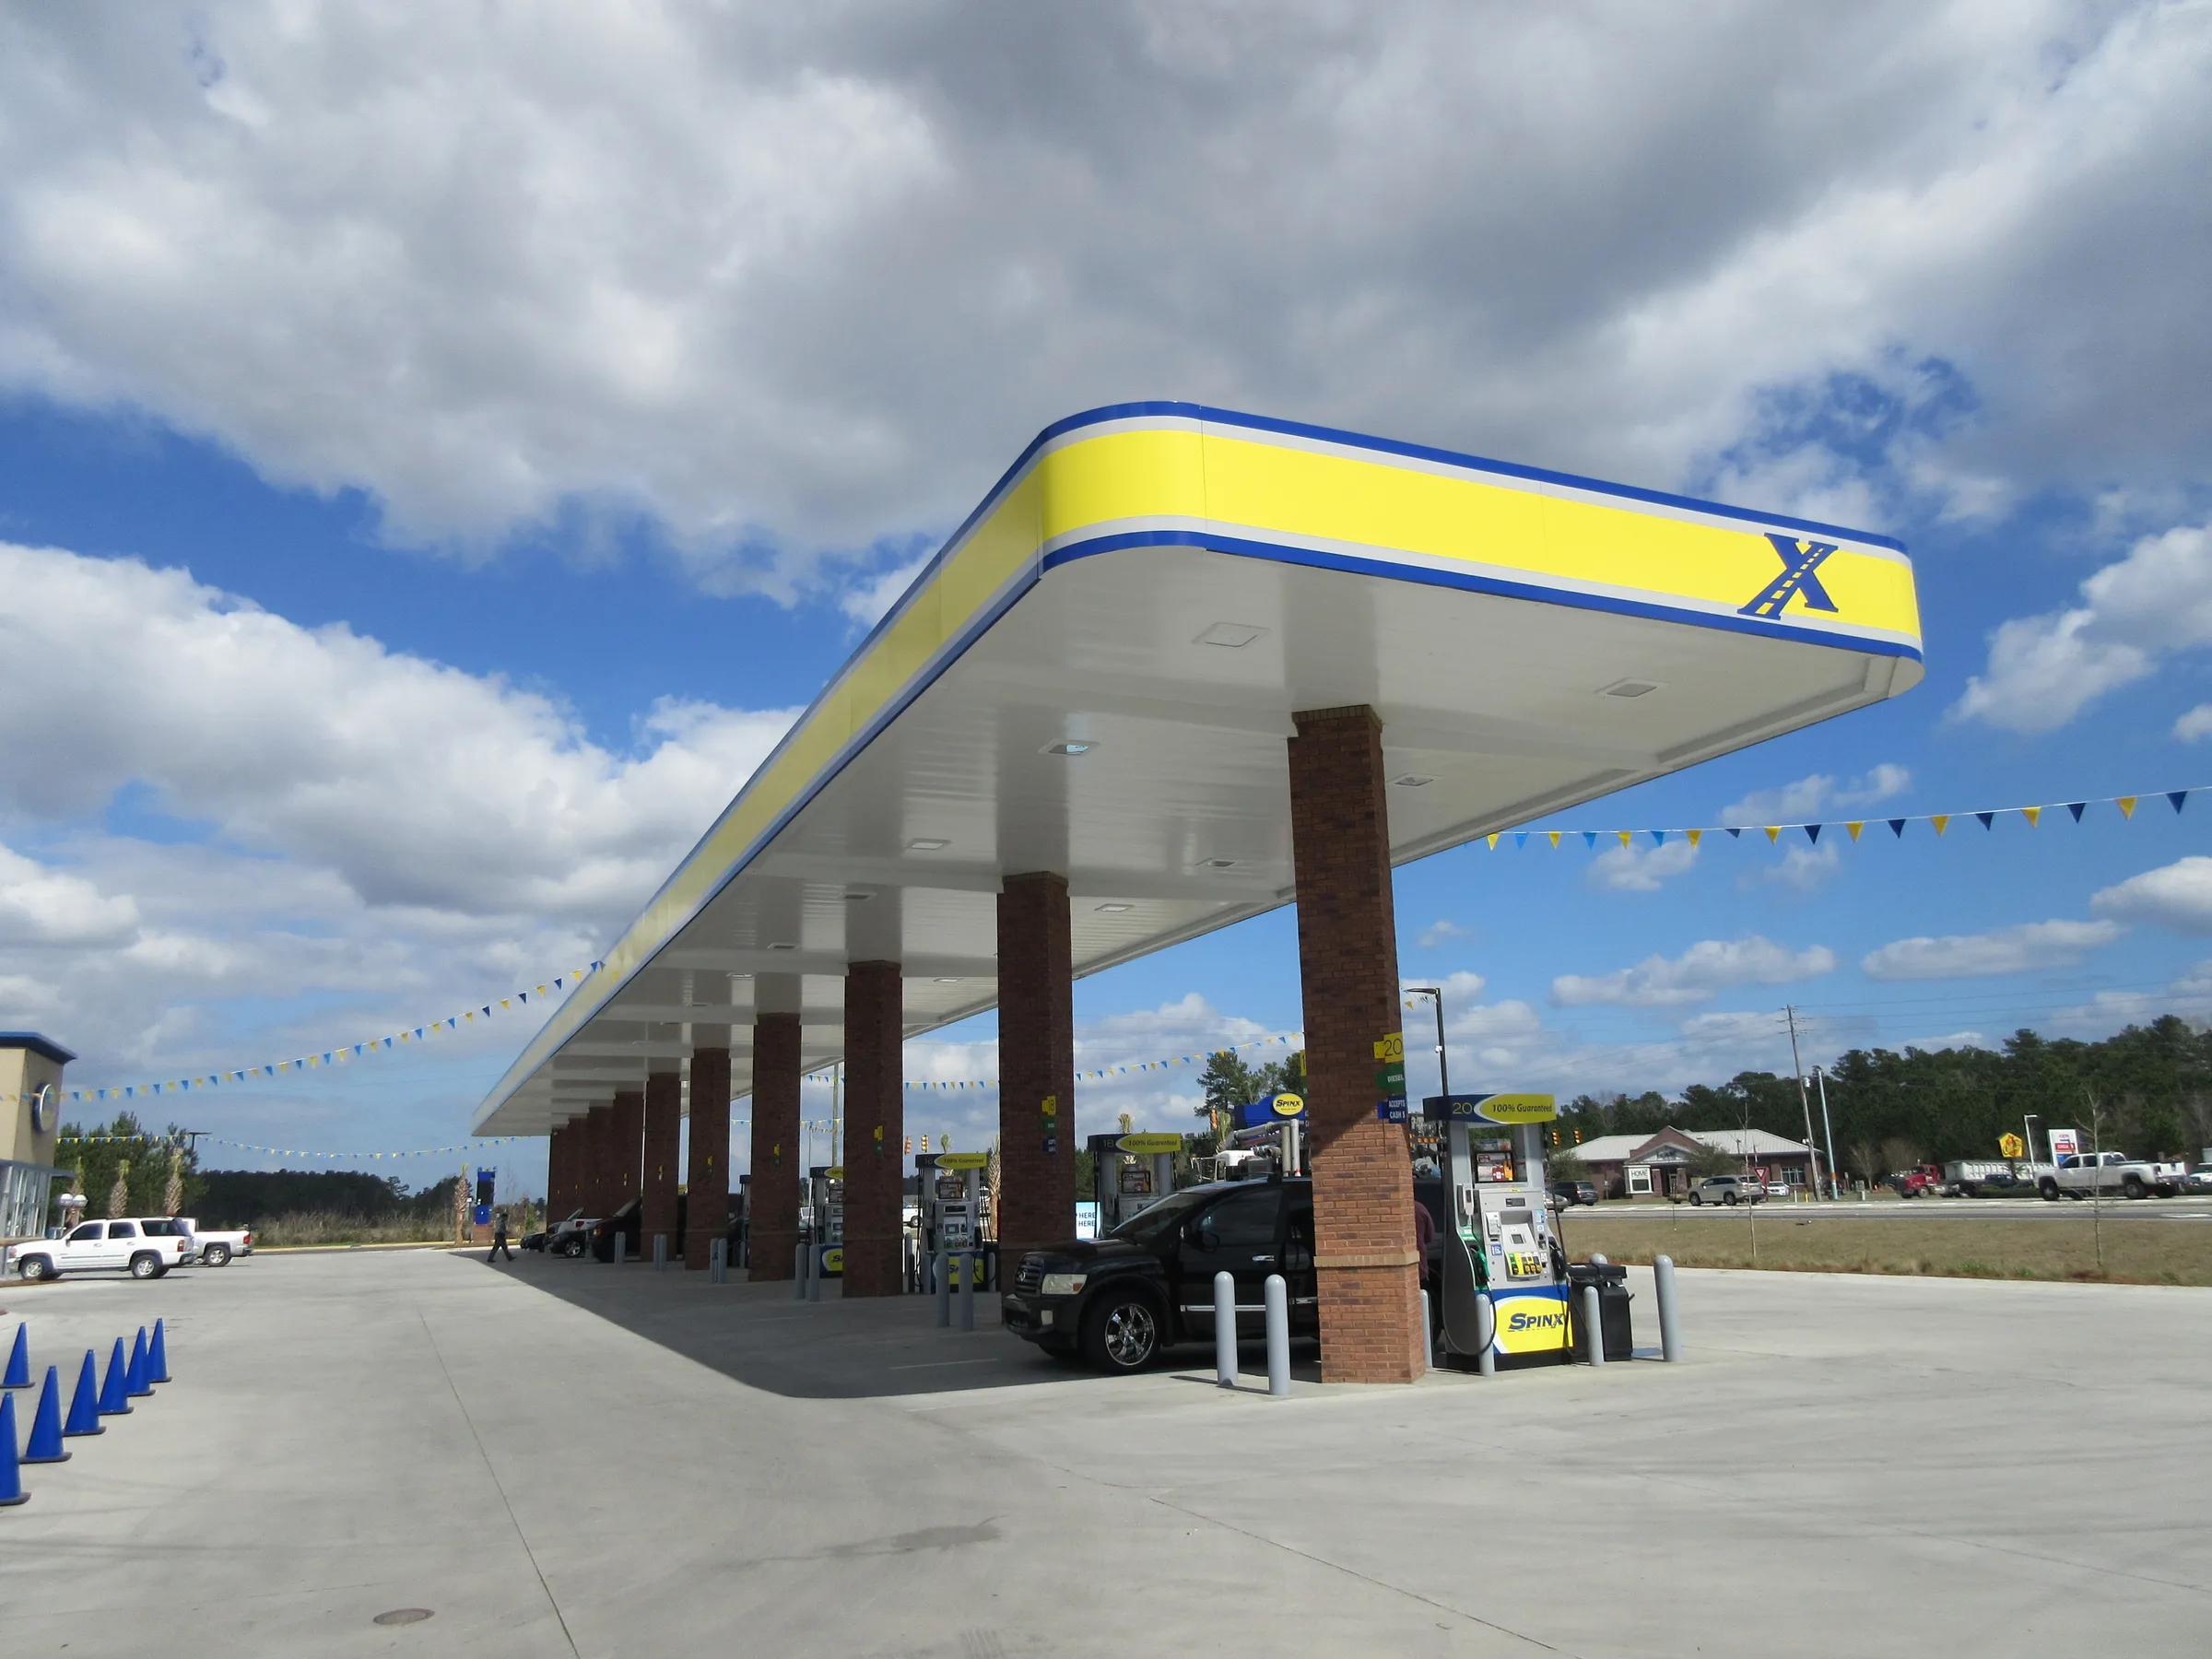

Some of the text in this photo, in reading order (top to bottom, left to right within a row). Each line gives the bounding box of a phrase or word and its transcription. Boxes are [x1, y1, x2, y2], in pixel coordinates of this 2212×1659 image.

[1384, 1038, 1403, 1057] 20
[1387, 1074, 1404, 1083] DIESEL
[1388, 1099, 1406, 1108] ACCEPTS
[1453, 1102, 1473, 1114] 20
[1492, 1102, 1553, 1113] 100% Guaranteed
[1389, 1110, 1401, 1119] CASH
[1630, 1169, 1648, 1179] HOME
[1508, 1312, 1564, 1330] SPINX
